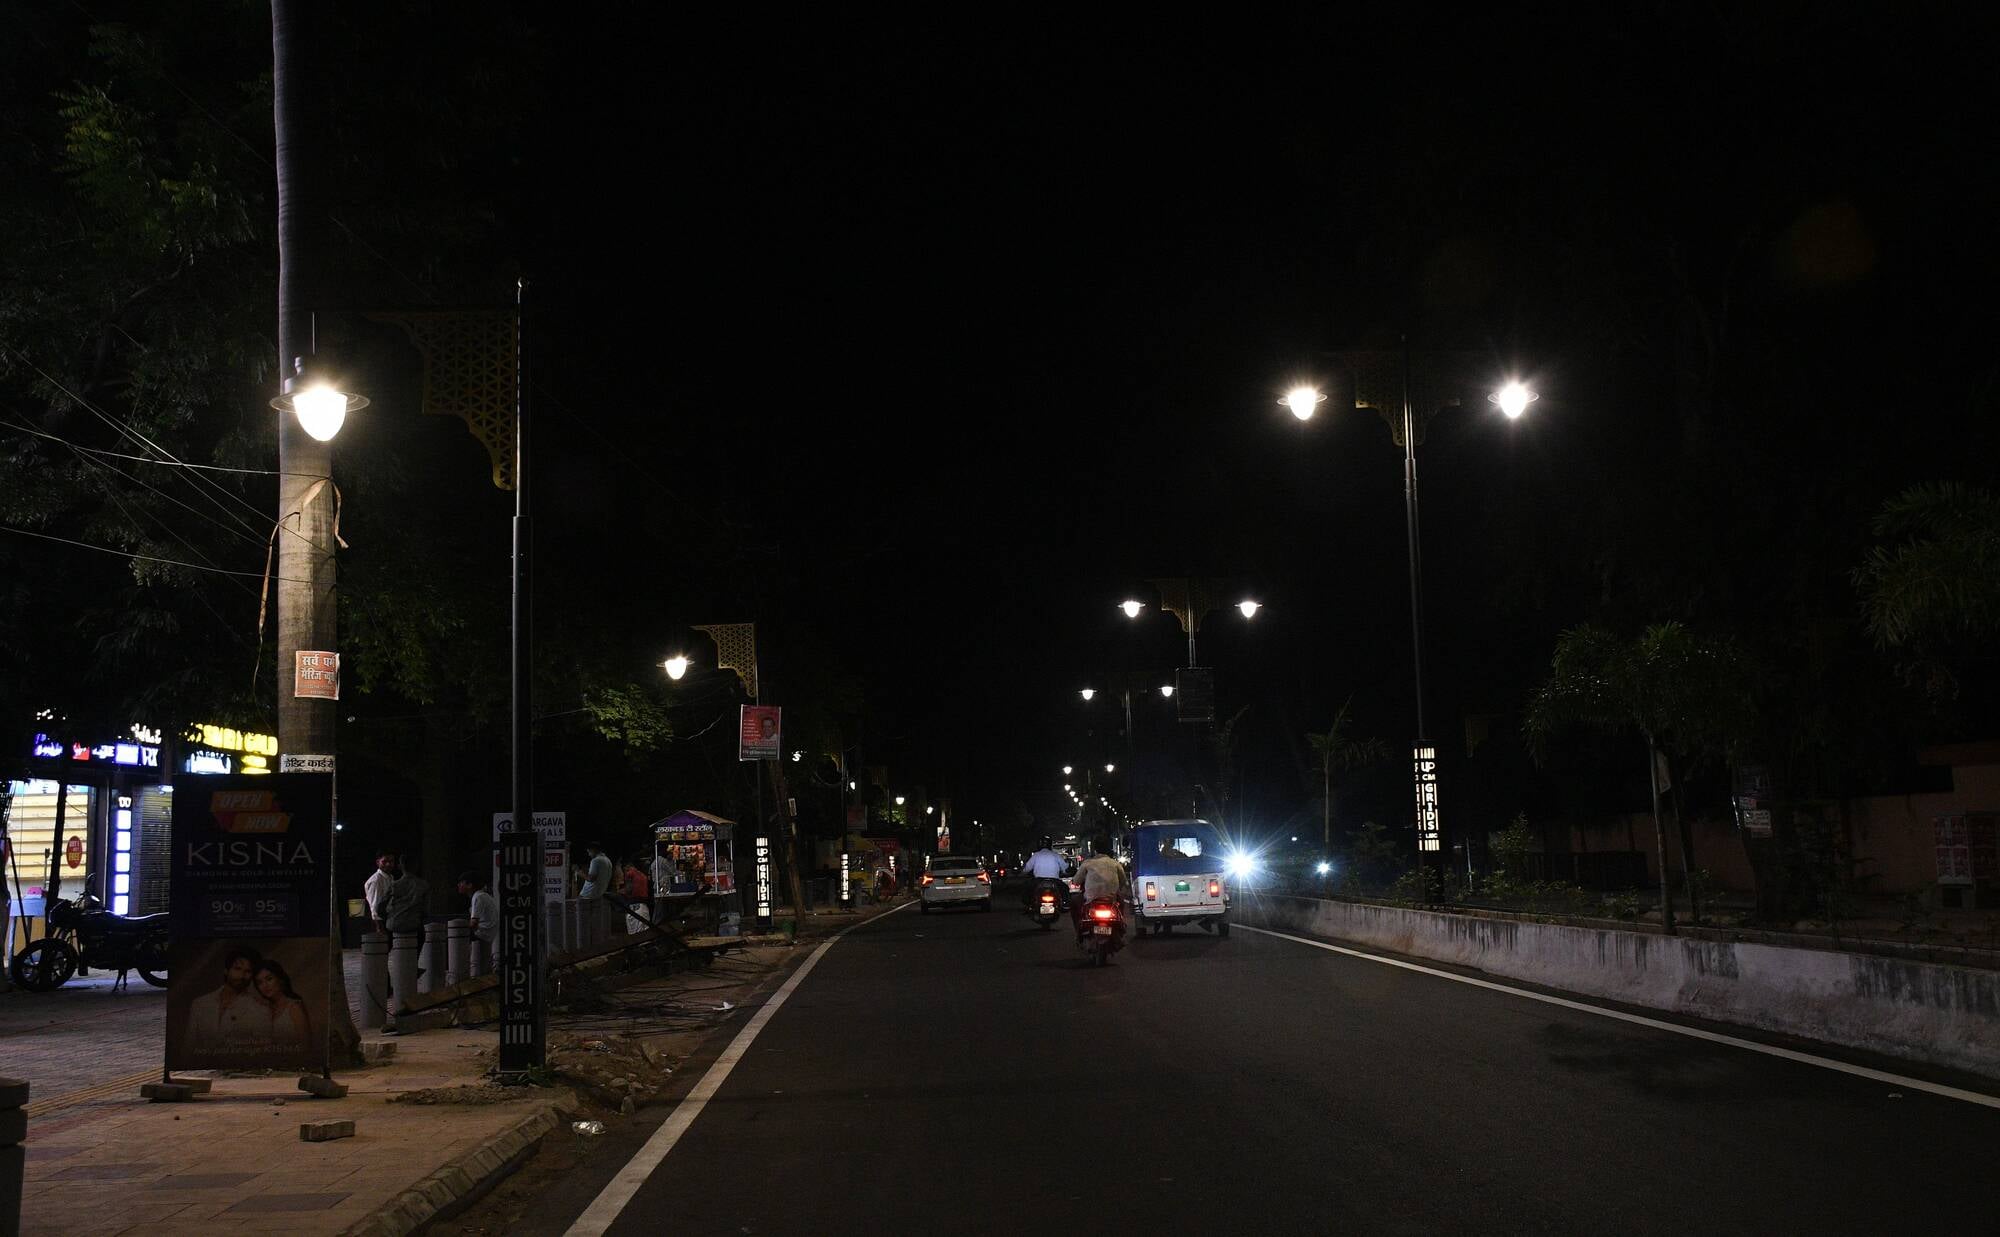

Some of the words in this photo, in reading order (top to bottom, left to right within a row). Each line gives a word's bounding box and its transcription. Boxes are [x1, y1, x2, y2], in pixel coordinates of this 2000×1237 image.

[1420, 761, 1436, 773] UP
[1424, 783, 1435, 830] GRIDS
[532, 817, 563, 827] ARGAVA
[186, 840, 315, 866] KISNA
[505, 872, 532, 893] UP
[759, 865, 767, 901] GRIDS
[506, 896, 531, 907] CM
[511, 914, 526, 1004] GRIDS
[506, 1011, 531, 1021] LMC
